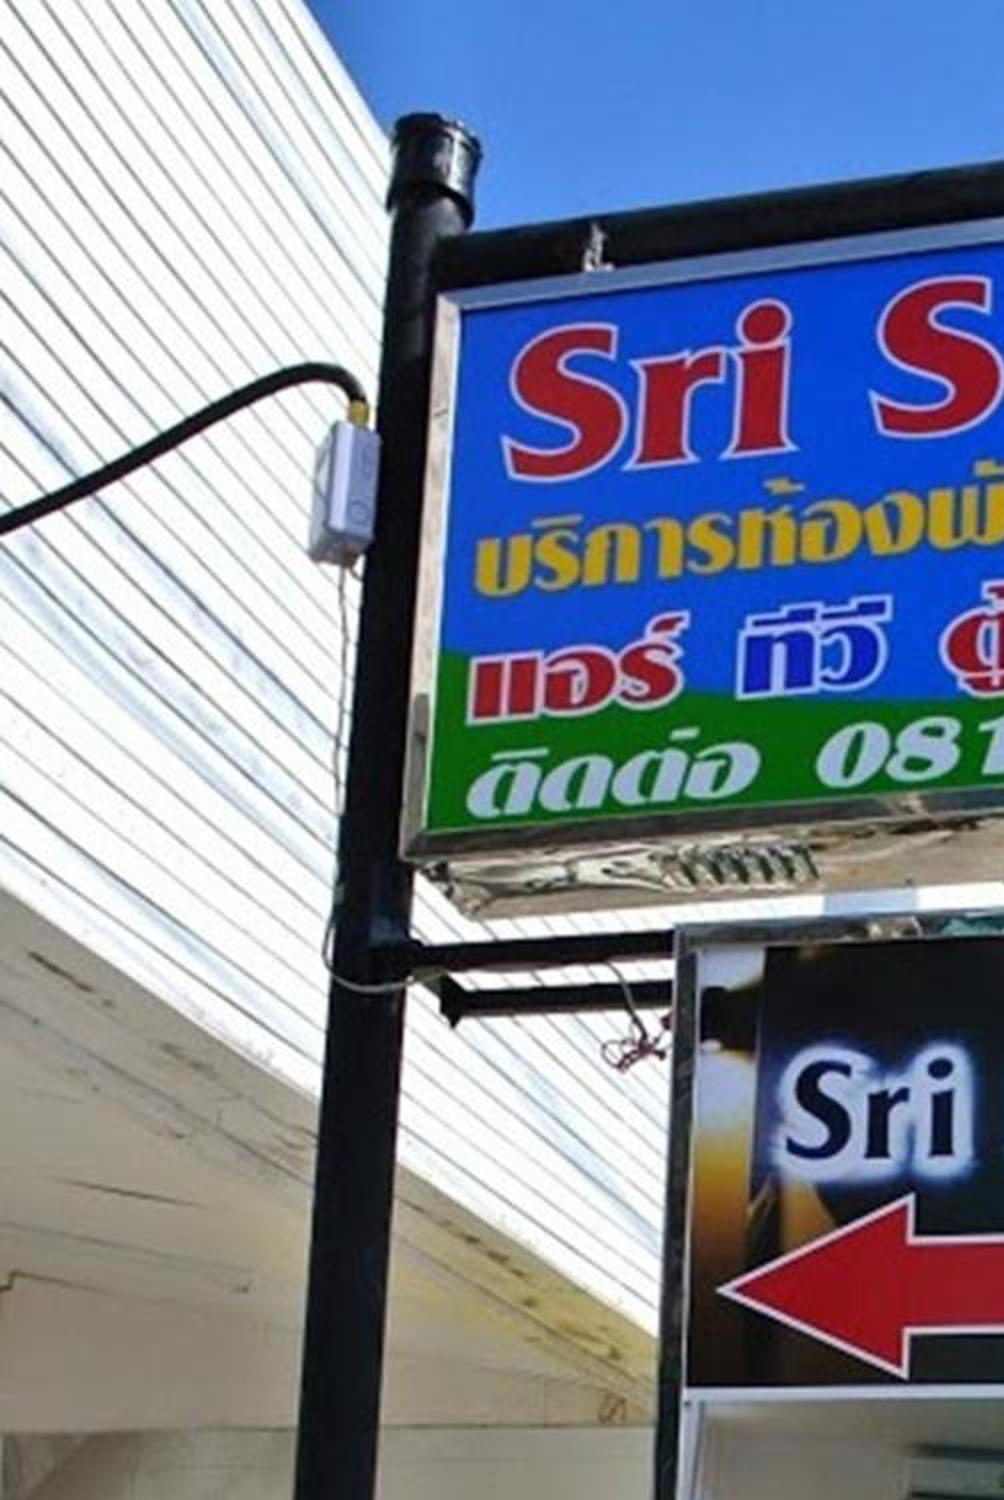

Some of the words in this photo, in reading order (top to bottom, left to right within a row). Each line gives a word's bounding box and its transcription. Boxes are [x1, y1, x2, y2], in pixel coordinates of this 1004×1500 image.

[502, 298, 797, 482] Sri
[466, 611, 690, 726] แอร์
[735, 594, 892, 698] ทีวี
[465, 726, 761, 818] ติดต่อ
[783, 1056, 958, 1160] Sri
